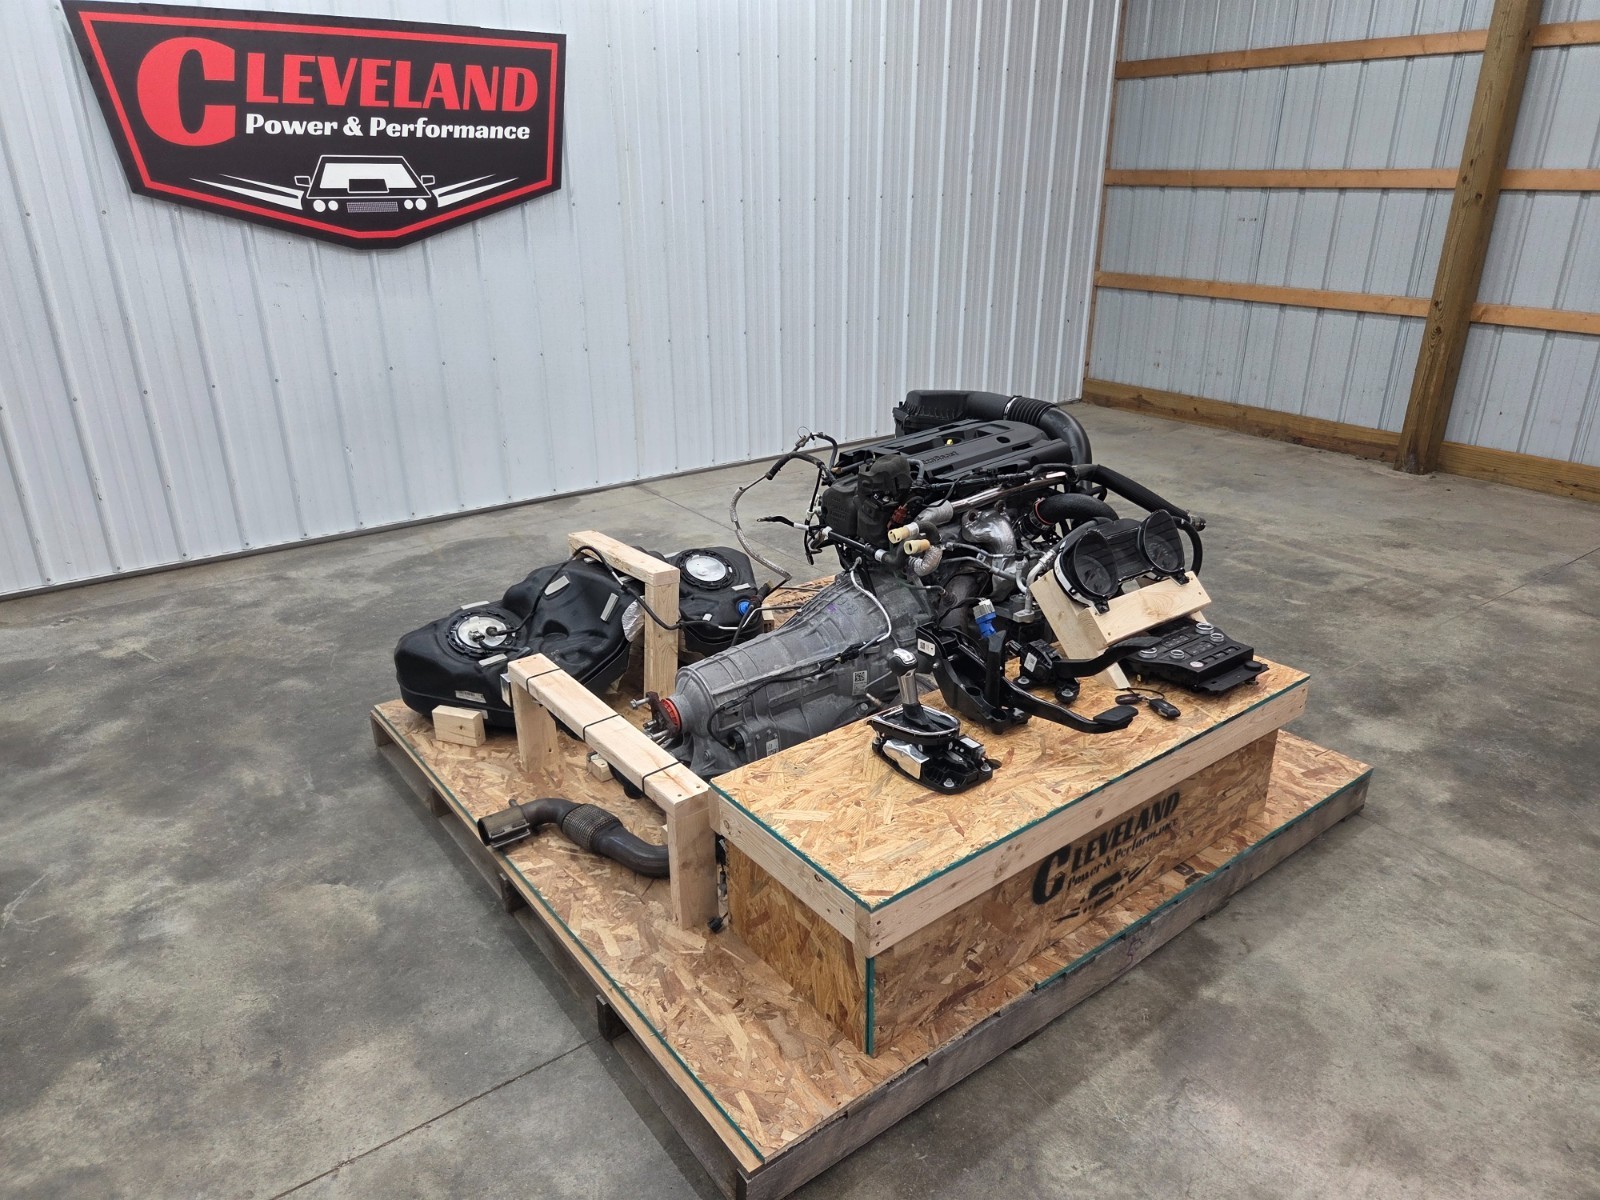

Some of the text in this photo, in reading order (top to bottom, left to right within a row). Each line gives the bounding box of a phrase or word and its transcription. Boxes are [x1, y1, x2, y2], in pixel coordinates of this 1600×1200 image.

[136, 36, 538, 147] CLEVELAND
[245, 113, 531, 140] Power & Performance
[1032, 792, 1180, 905] CLEVELAND
